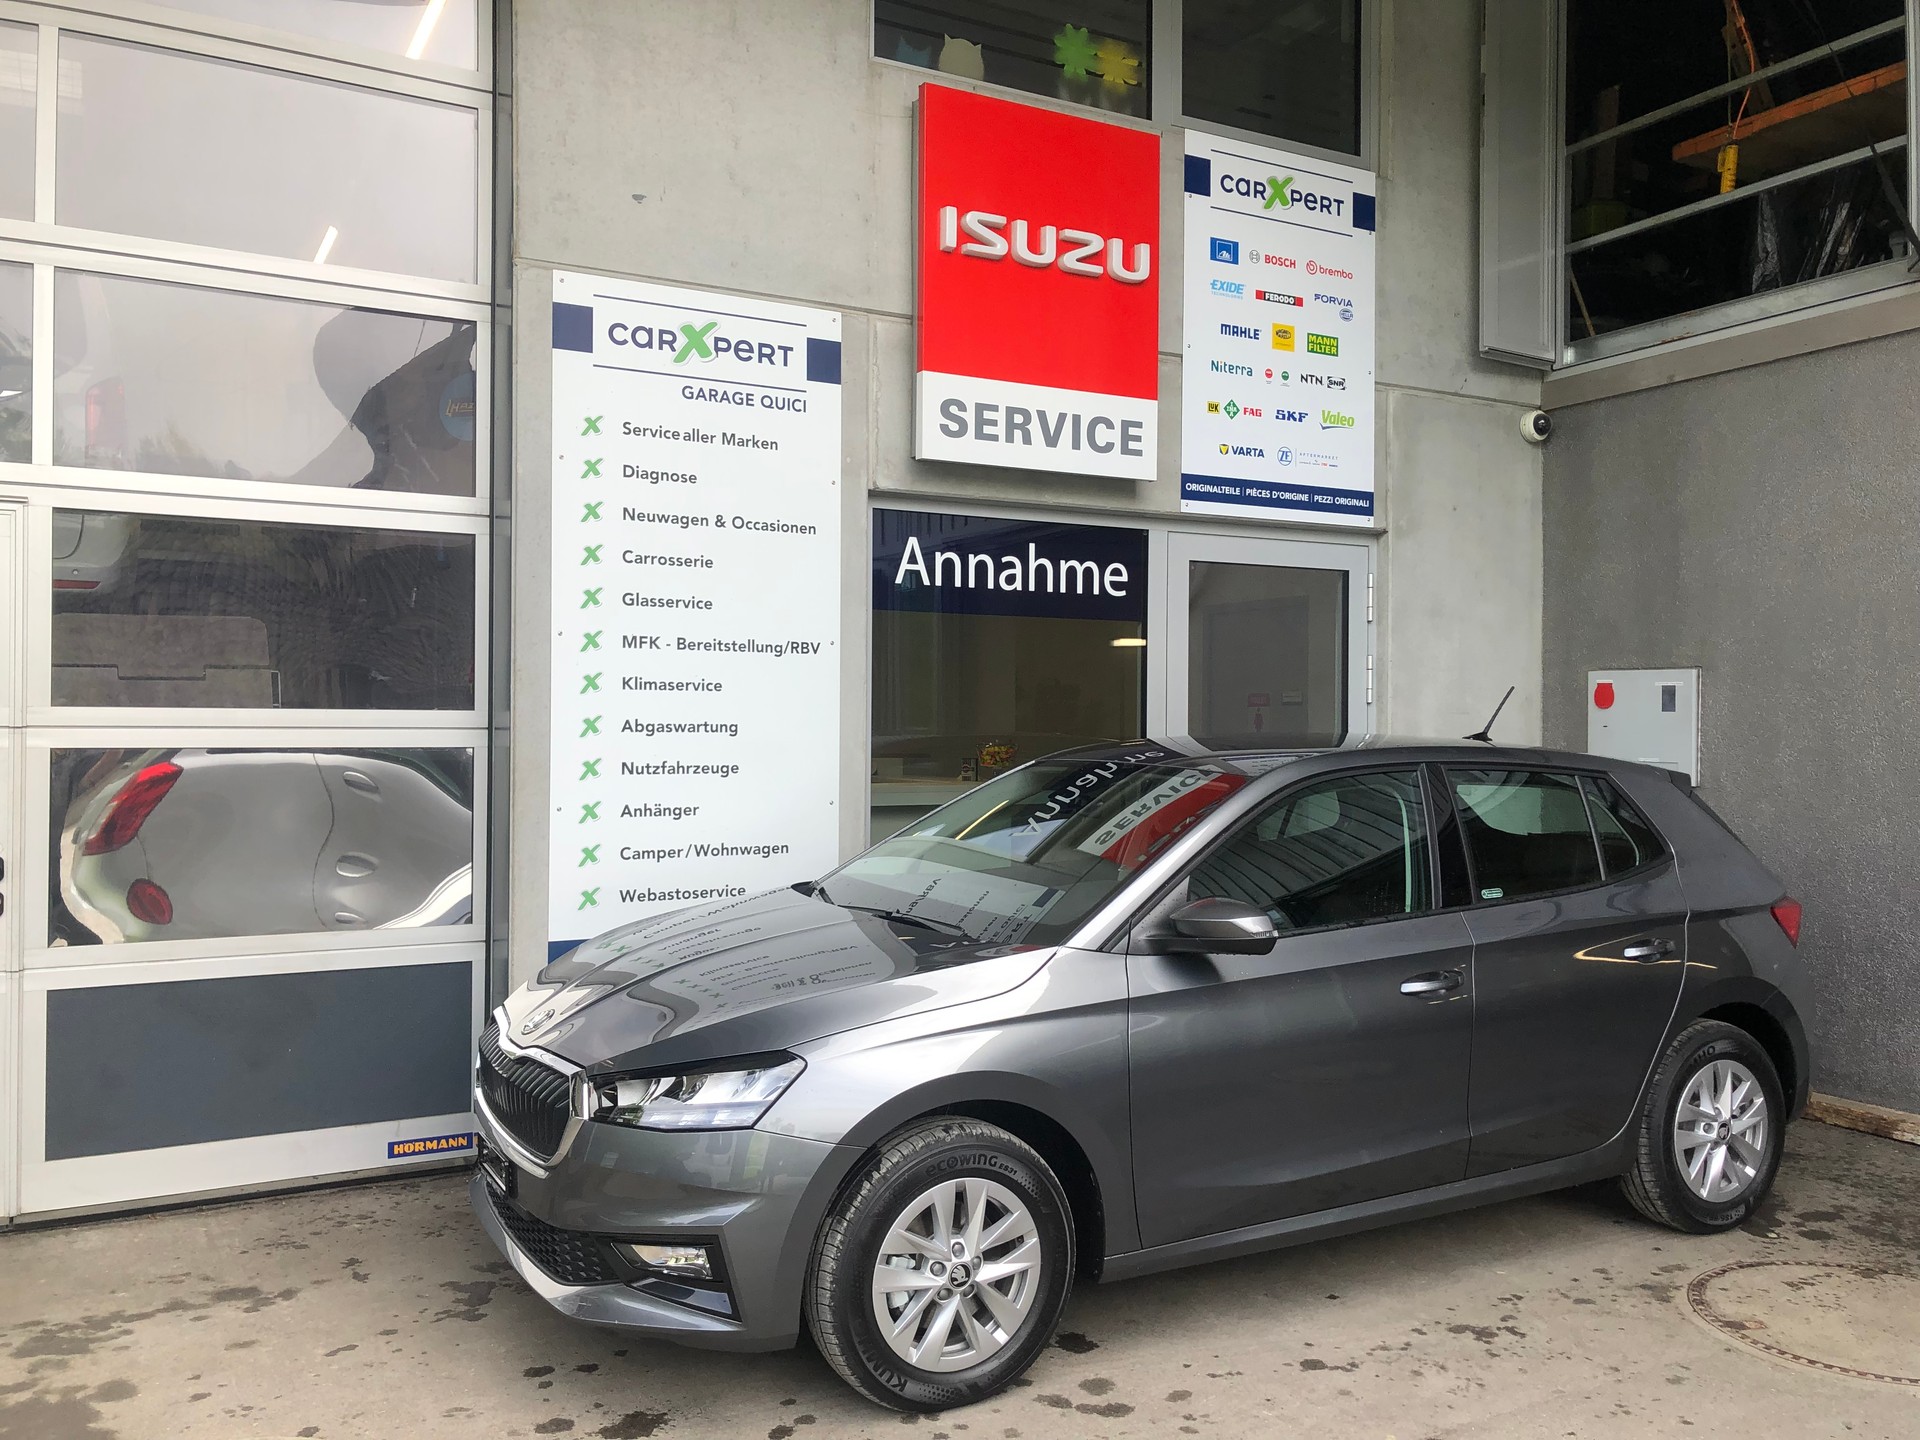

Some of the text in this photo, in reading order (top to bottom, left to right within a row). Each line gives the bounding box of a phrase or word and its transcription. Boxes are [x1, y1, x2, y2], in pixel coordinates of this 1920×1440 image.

[939, 205, 1151, 284] ISUZU
[1264, 254, 1296, 269] BOSCH
[1319, 264, 1353, 280] brembo
[1210, 279, 1244, 295] EXIDE
[1264, 292, 1295, 305] FERODO
[1314, 293, 1353, 308] FORVIA
[1220, 323, 1260, 341] MAHLE
[1308, 334, 1338, 347] MANN
[1308, 343, 1338, 356] FILTER
[1210, 360, 1253, 377] Niterra
[1301, 373, 1323, 386] NTN
[1327, 378, 1345, 389] SNR
[681, 385, 807, 413] GARAGE QUICI
[1243, 406, 1262, 418] FAG
[1275, 409, 1308, 423] SKF
[1321, 409, 1355, 428] Valeo
[622, 421, 779, 451] Service aller Marken
[939, 398, 1144, 457] SERVICE
[1231, 445, 1265, 459] VARTA
[1278, 450, 1292, 463] ZF
[622, 464, 698, 485] Diagnose
[1185, 482, 1369, 508] ORIGINALTEILE PIÈCES D'ORIGINE PEZZI ORIGINALI
[622, 506, 817, 535] Neuwagen & Occasionen
[622, 550, 714, 569] Carrosserie
[894, 536, 1129, 597] Annahme
[622, 592, 714, 610] Glasservice
[622, 634, 661, 650] MFK
[676, 637, 821, 657] Bereitstellung/RBV
[622, 677, 723, 692] Klimaservice
[621, 719, 739, 737] Abgaswartung
[621, 761, 740, 778] Nutzfahrzeuge
[620, 803, 700, 820] Anhänger
[620, 885, 747, 903] Webastoservice
[393, 1136, 468, 1155] HÖRMANN
